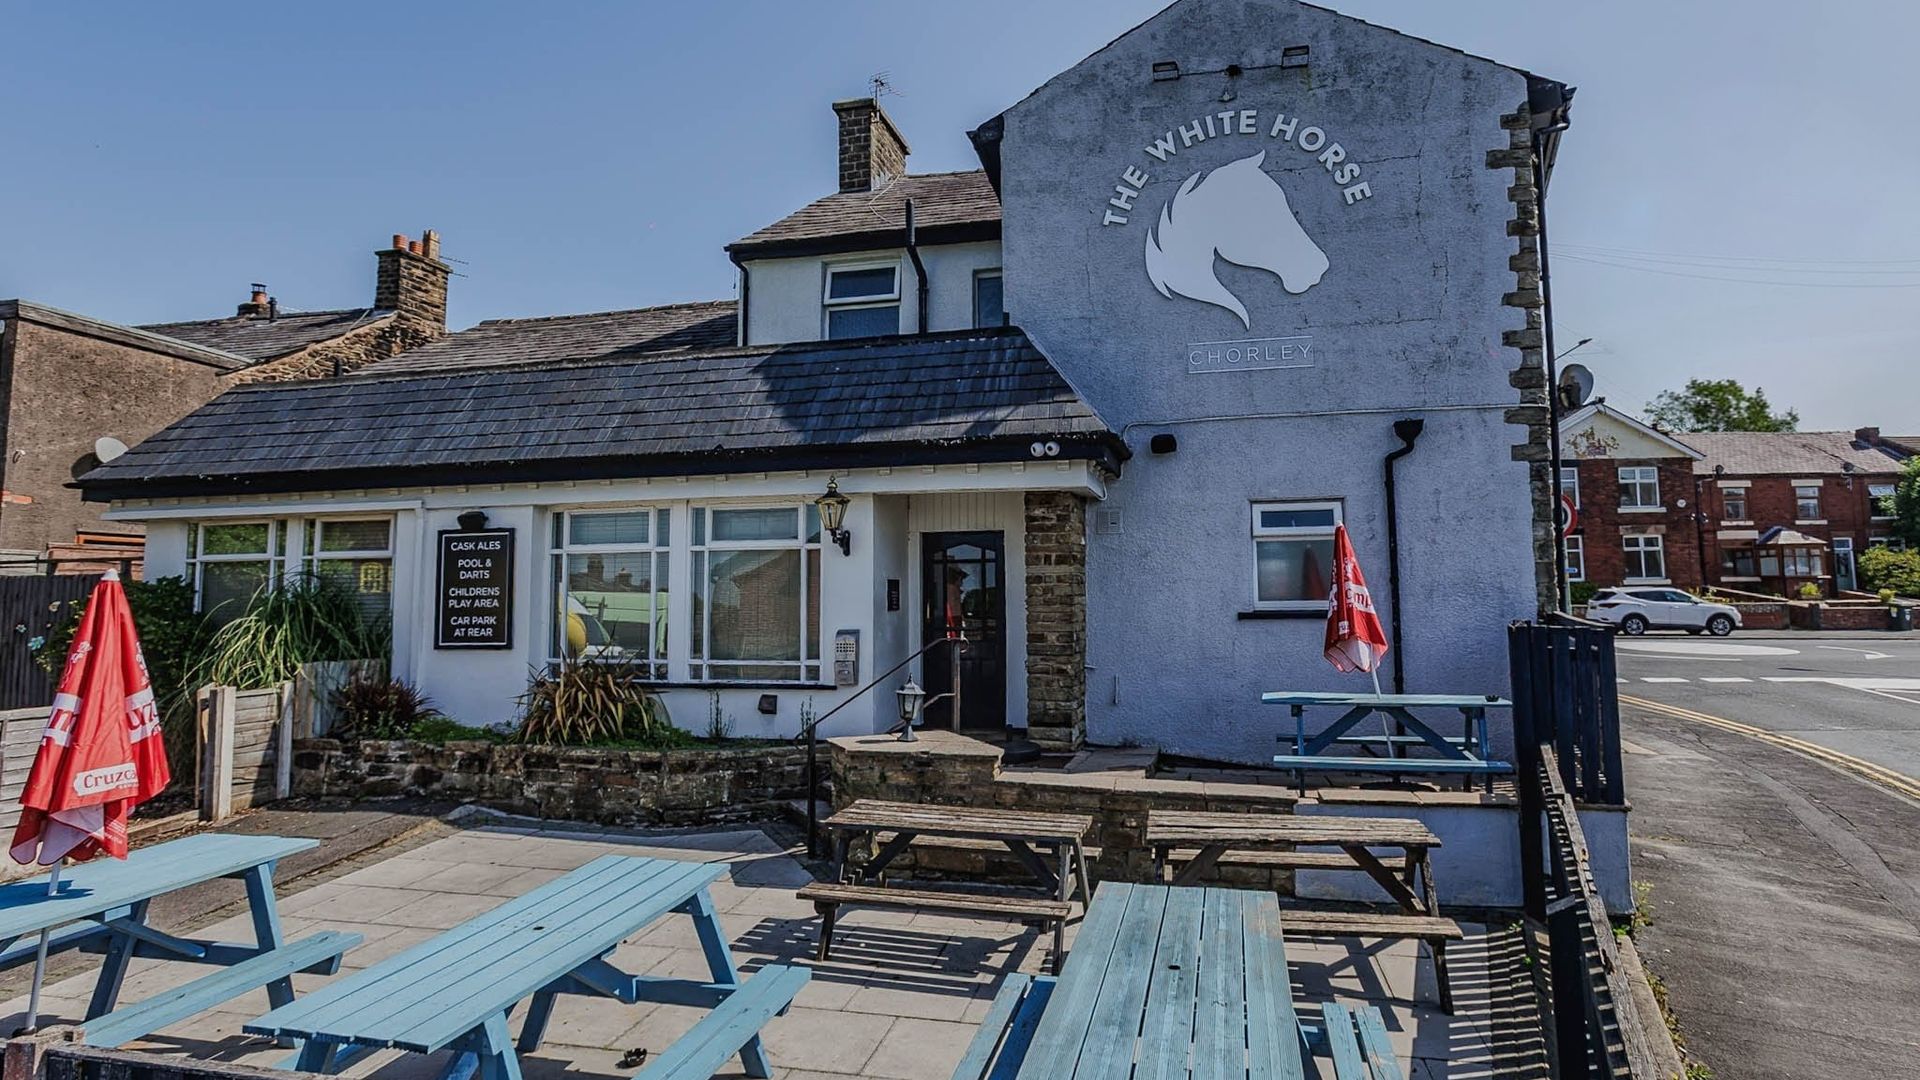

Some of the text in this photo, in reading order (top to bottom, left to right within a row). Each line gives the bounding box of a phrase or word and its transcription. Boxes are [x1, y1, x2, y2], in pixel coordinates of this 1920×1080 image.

[1103, 109, 1373, 226] THE WHITE HORSE
[1189, 344, 1312, 366] CHORLEY
[450, 541, 501, 551] CASK ALES
[458, 559, 492, 568] POOL &
[459, 570, 490, 579] DARTS
[448, 587, 500, 596] CHILDRENS
[448, 599, 499, 608] PLAY AREA
[450, 616, 497, 625] CAR PARK
[453, 628, 493, 637] AT REAR
